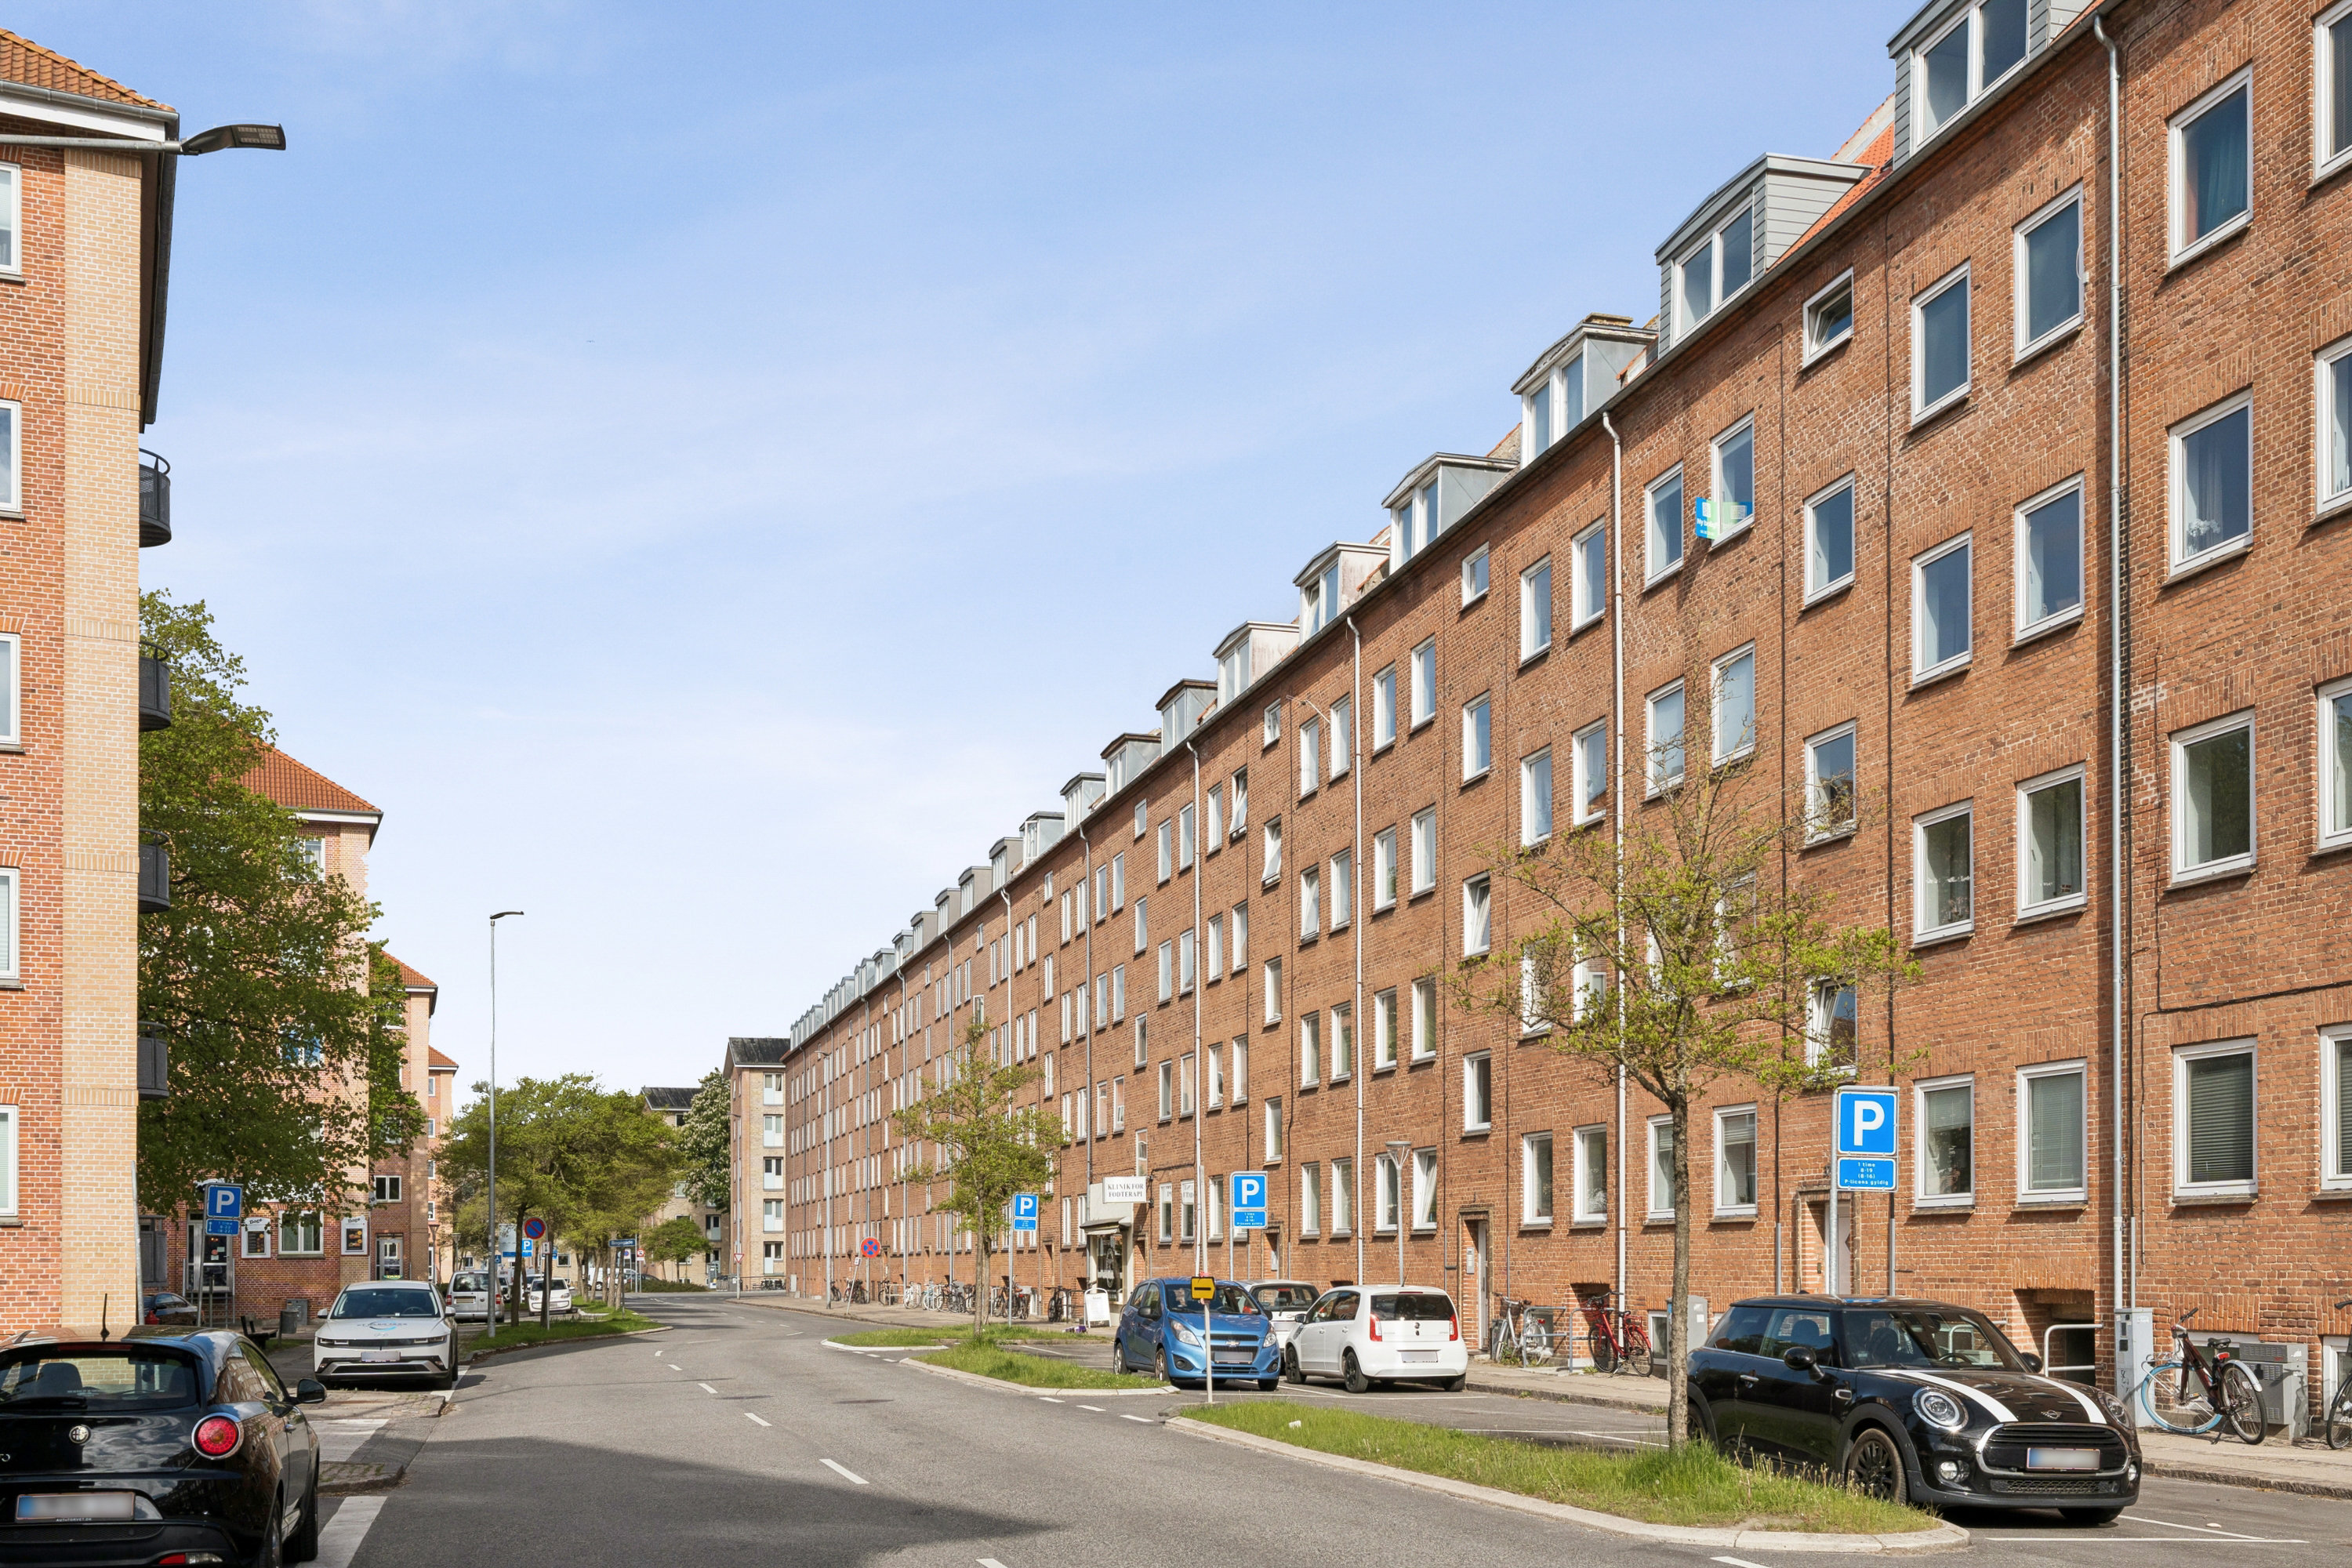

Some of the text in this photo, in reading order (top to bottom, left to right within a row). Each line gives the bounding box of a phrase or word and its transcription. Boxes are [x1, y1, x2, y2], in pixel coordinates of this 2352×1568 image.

[1853, 1100, 1885, 1145] P
[216, 1190, 234, 1213] P
[1241, 1179, 1260, 1204] P
[1020, 1197, 1033, 1214] P
[523, 1240, 531, 1250] P
